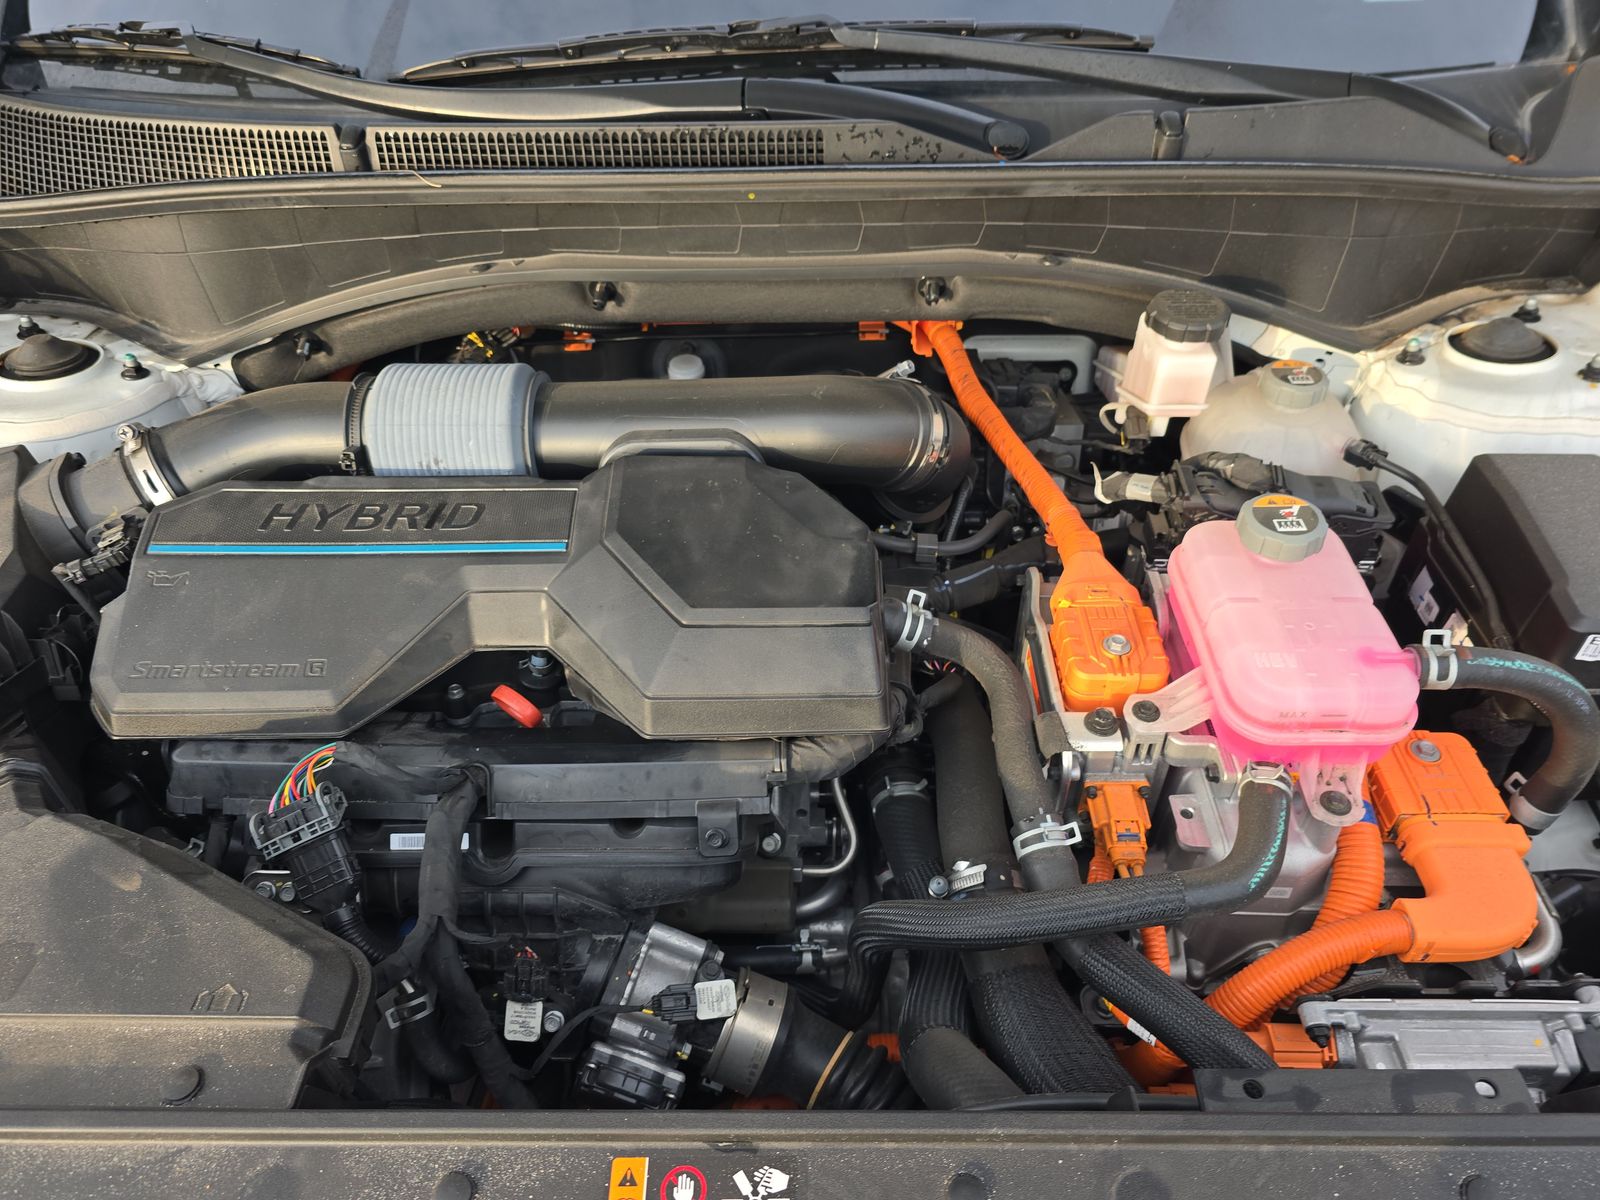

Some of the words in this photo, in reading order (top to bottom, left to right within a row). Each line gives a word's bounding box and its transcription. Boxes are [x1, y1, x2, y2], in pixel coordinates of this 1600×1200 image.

[257, 502, 487, 532] HYBRID
[128, 660, 300, 680] Smartstream
[304, 658, 328, 678] G
[1278, 711, 1309, 719] MAX
